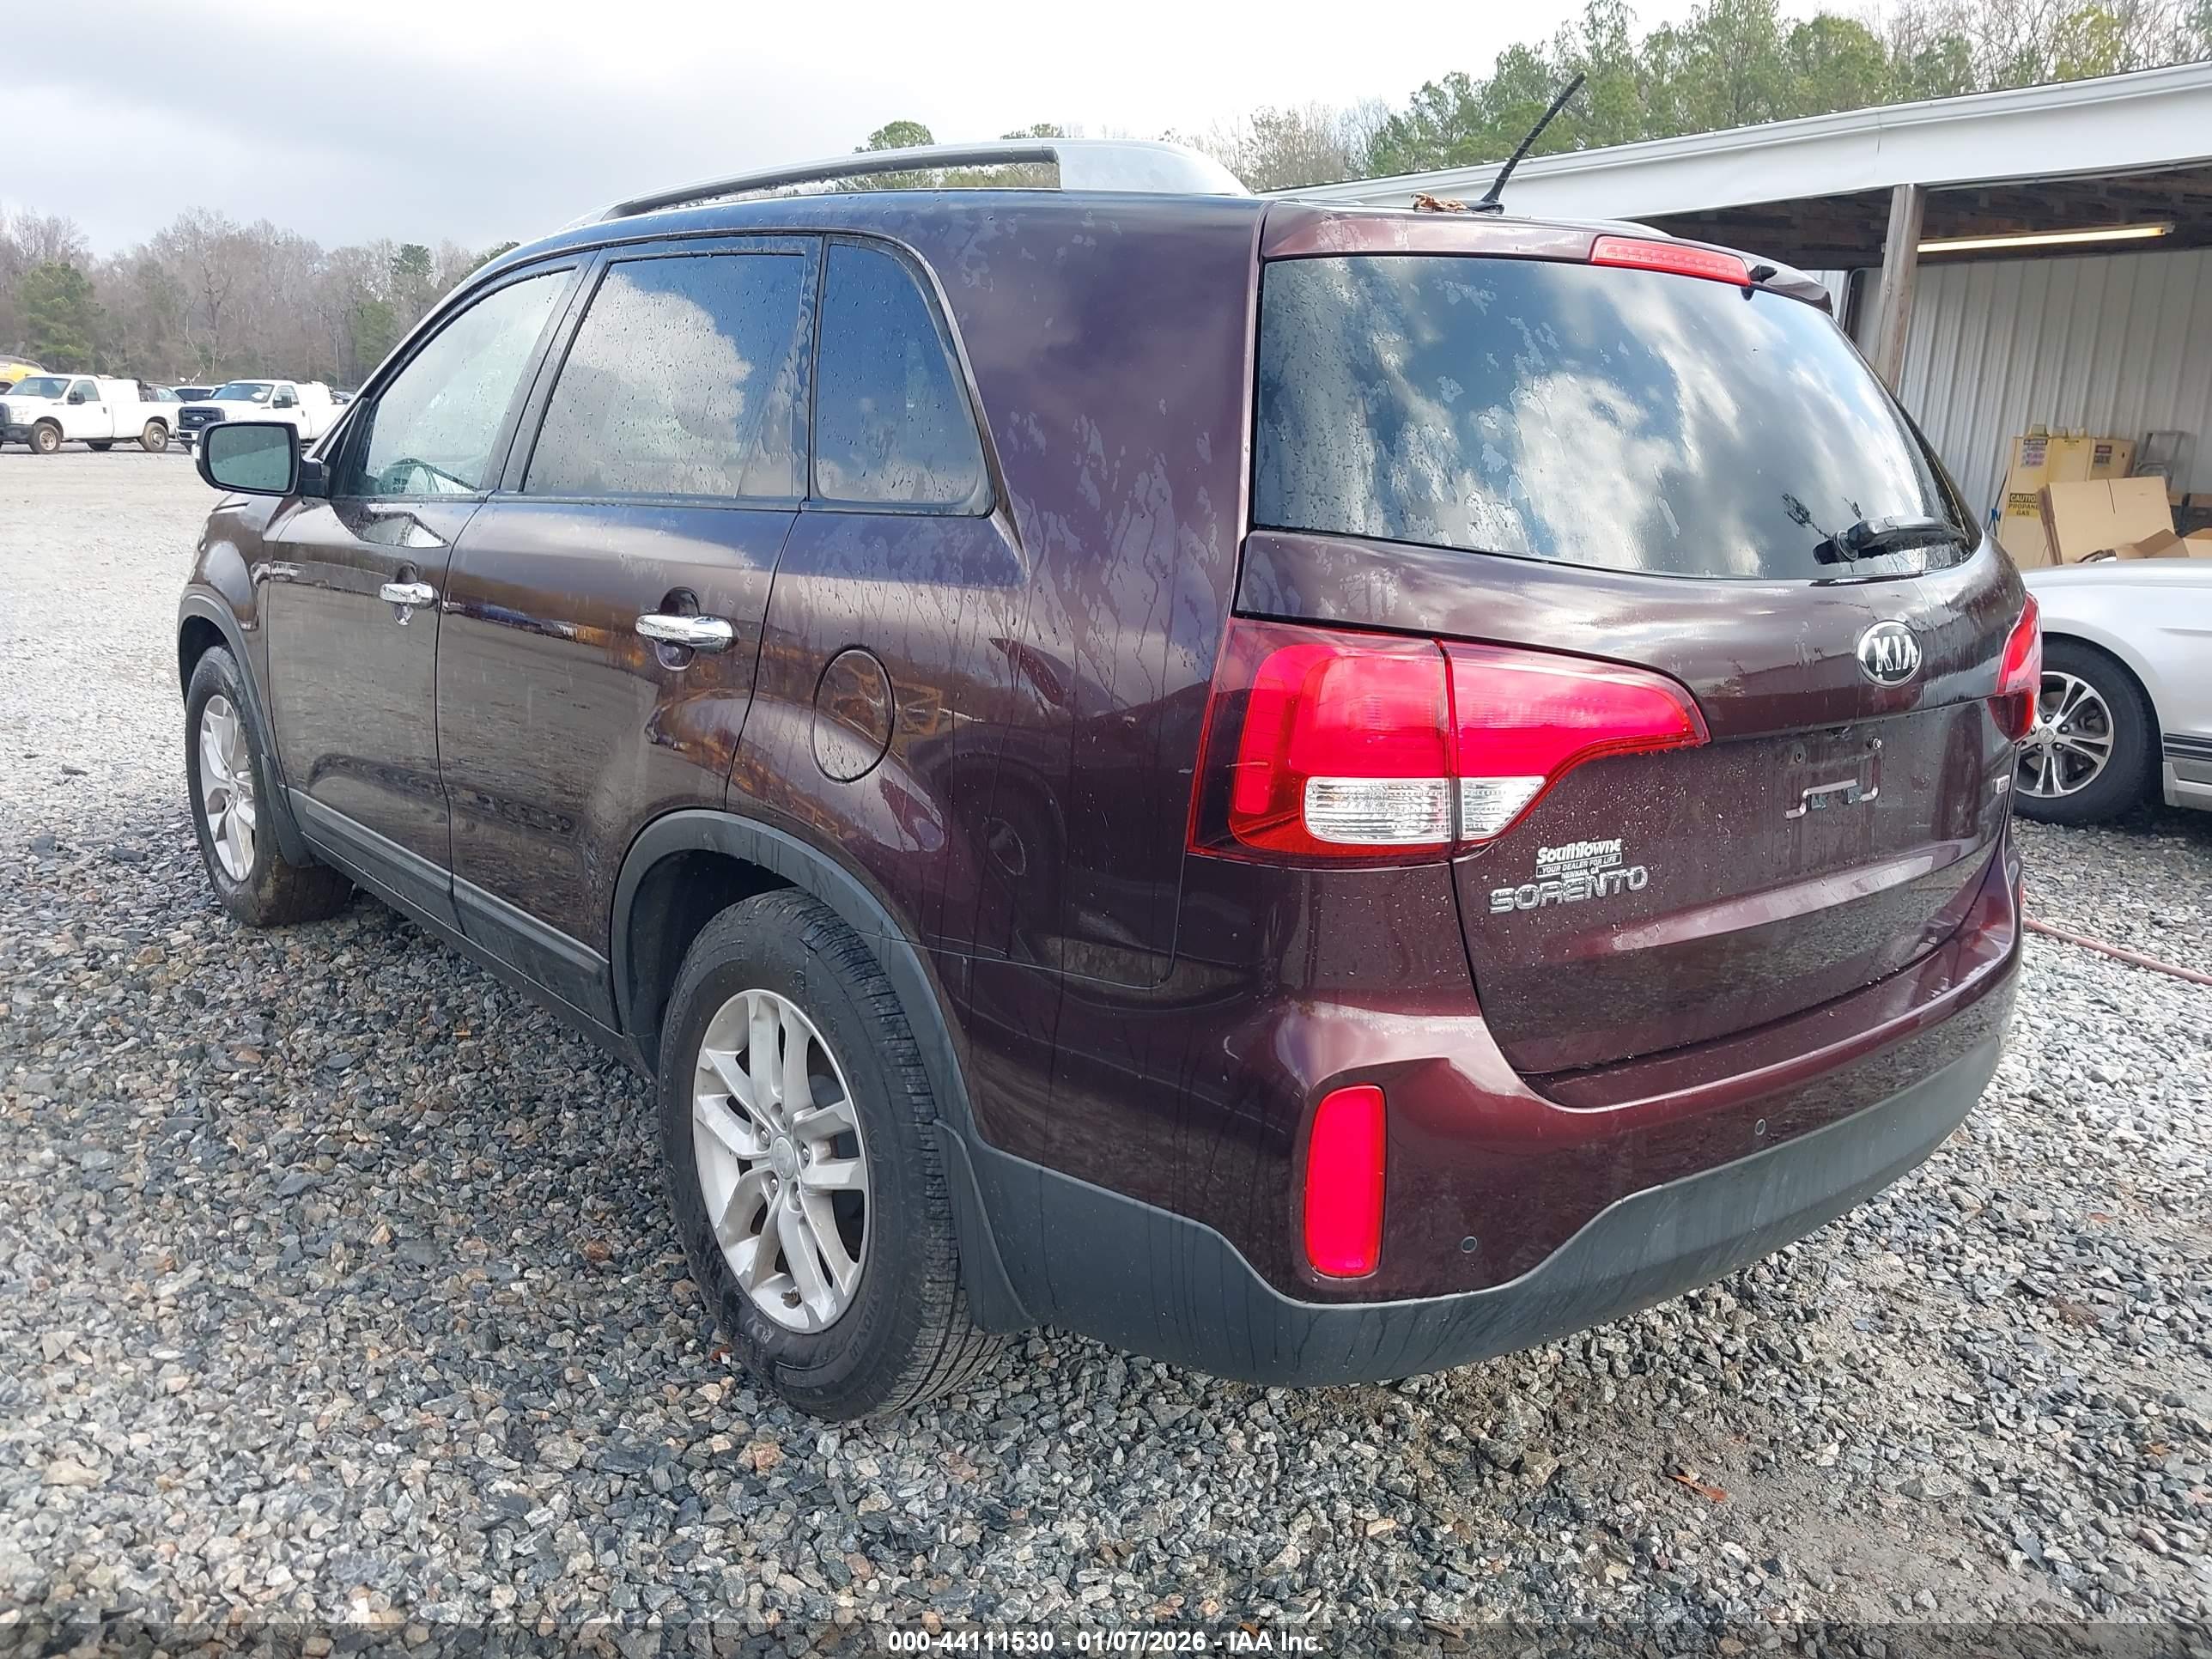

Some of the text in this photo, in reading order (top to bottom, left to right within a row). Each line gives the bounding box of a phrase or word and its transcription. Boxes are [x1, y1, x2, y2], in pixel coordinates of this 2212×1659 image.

[2010, 494, 2036, 502] CAUTIO
[1873, 635, 1918, 672] KIA
[1541, 855, 1617, 874] YOUR DEALER FOR LIFE
[1489, 866, 1649, 914] SORENTO
